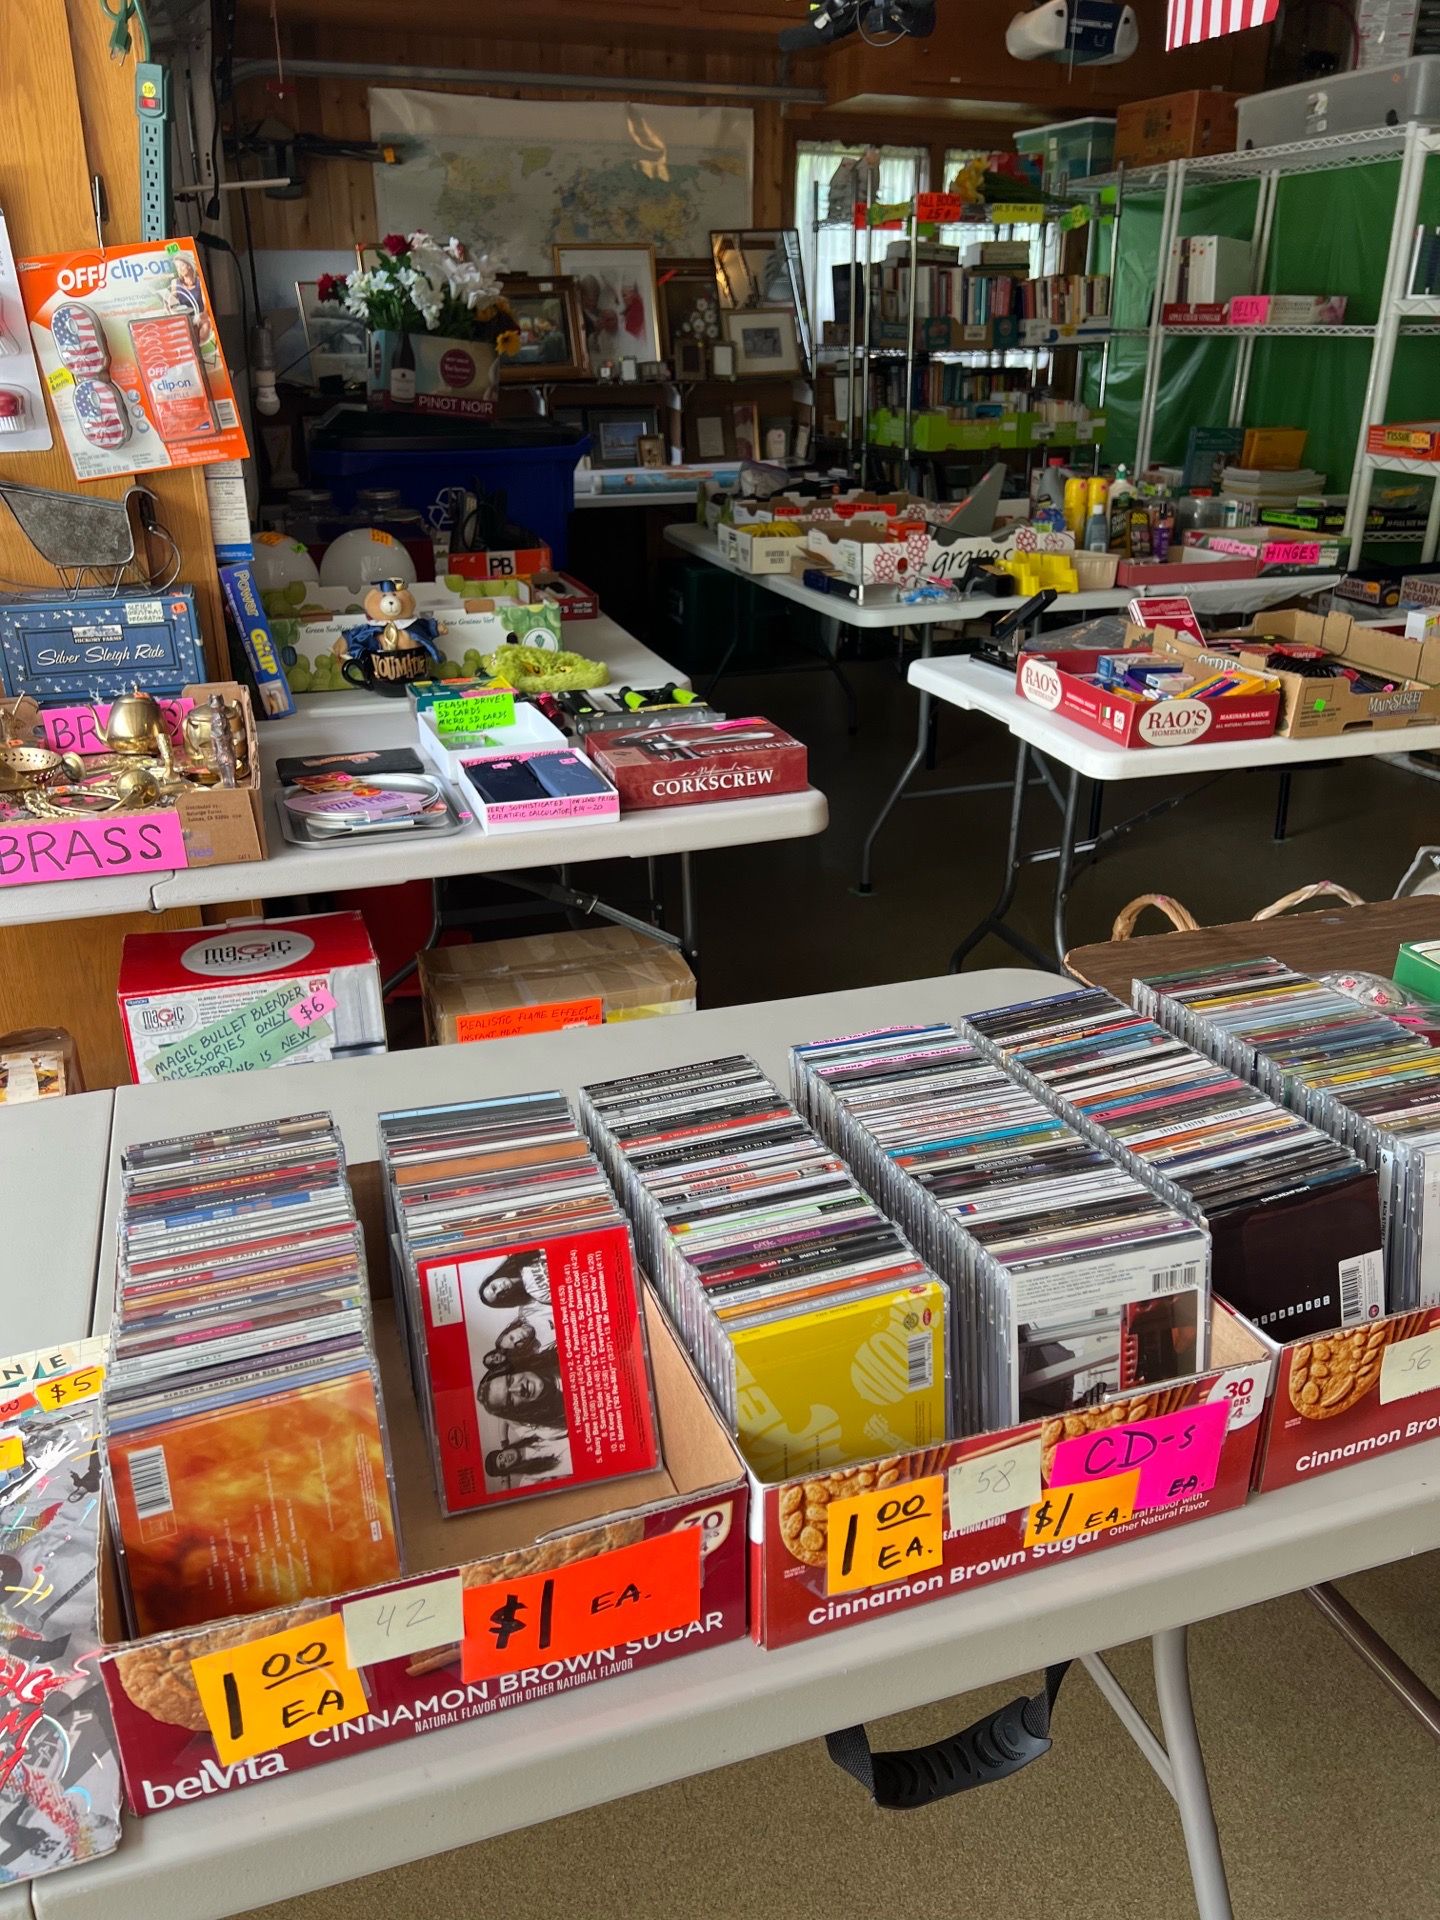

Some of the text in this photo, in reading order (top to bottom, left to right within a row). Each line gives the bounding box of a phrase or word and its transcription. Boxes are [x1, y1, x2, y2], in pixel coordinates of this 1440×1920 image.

[57, 262, 107, 291] OFF!
[147, 367, 168, 377] OFF!
[418, 396, 493, 414] PINOT NOIR
[1265, 545, 1317, 561] HINGES
[489, 557, 514, 577] PB
[37, 643, 165, 667] Silver Sleigh Ride
[1025, 666, 1058, 697] RAO'S
[438, 694, 506, 709] FLASH DRIVES
[453, 706, 480, 716] CARDS
[439, 718, 464, 727] MICRO
[483, 711, 507, 721] CARDS
[1147, 709, 1208, 730] RAO'S
[1219, 712, 1250, 721] MARINARA
[1151, 728, 1199, 737] HOMEMADE
[699, 740, 800, 756] CORKSCREW
[651, 768, 774, 797] CORKSCREW
[487, 799, 564, 813] VERY SOPHISTICATED
[487, 807, 570, 821] SCIENTIFIC CALCULATOR
[0, 823, 163, 875] BRASS
[299, 995, 325, 1021] $6
[459, 1005, 592, 1031] REALISTIC FLAME EFFECT
[154, 1044, 198, 1076] MAGIC
[199, 1013, 249, 1049] BULLET
[250, 985, 305, 1022] BLENDER
[255, 1010, 288, 1036] ONLY
[460, 1026, 522, 1042] INSTANT HEAT
[259, 1026, 311, 1062] IS NEW
[172, 1241, 300, 1273] DANCE with SANTA CLAUS
[134, 1273, 202, 1293] CIRCUIT CITY
[572, 1269, 580, 1287] Cool
[598, 1270, 608, 1310] Recordman
[575, 1288, 583, 1308] Damn
[584, 1292, 592, 1315] Cradle
[591, 1291, 599, 1313] About
[577, 1309, 584, 1320] So
[594, 1314, 604, 1352] Everything
[566, 1284, 591, 1443] Come Tomorrow Panhandlin' Prince
[583, 1354, 590, 1365] Go
[1400, 1345, 1432, 1372] 56
[50, 1367, 96, 1405] $5
[1224, 1377, 1254, 1397] 30
[572, 1392, 581, 1425] Neighbor
[604, 1391, 612, 1410] Tryin'
[598, 1407, 606, 1429] Same
[615, 1409, 624, 1440] Madman
[1295, 1427, 1401, 1472] Cinnamon
[976, 1459, 1017, 1495] 58
[1166, 1478, 1205, 1498] EA.
[1033, 1493, 1127, 1535] $1 EA.
[1149, 1490, 1204, 1516] Flavor with
[1109, 1499, 1210, 1537] Other Natural Flavor
[841, 1494, 926, 1576] 1 00
[877, 1542, 934, 1570] EA.
[807, 1527, 1103, 1627] Cinnamon Brown Sugar
[376, 1598, 436, 1637] 42
[488, 1578, 653, 1650] $1 EA.
[223, 1641, 328, 1740] 1 00
[309, 1610, 725, 1748] CINNAMON BROWN SUGAR
[415, 1657, 634, 1733] NATURAL FLAVOR WITH OTHER NATURAL FLAVOR
[282, 1689, 345, 1730] EA
